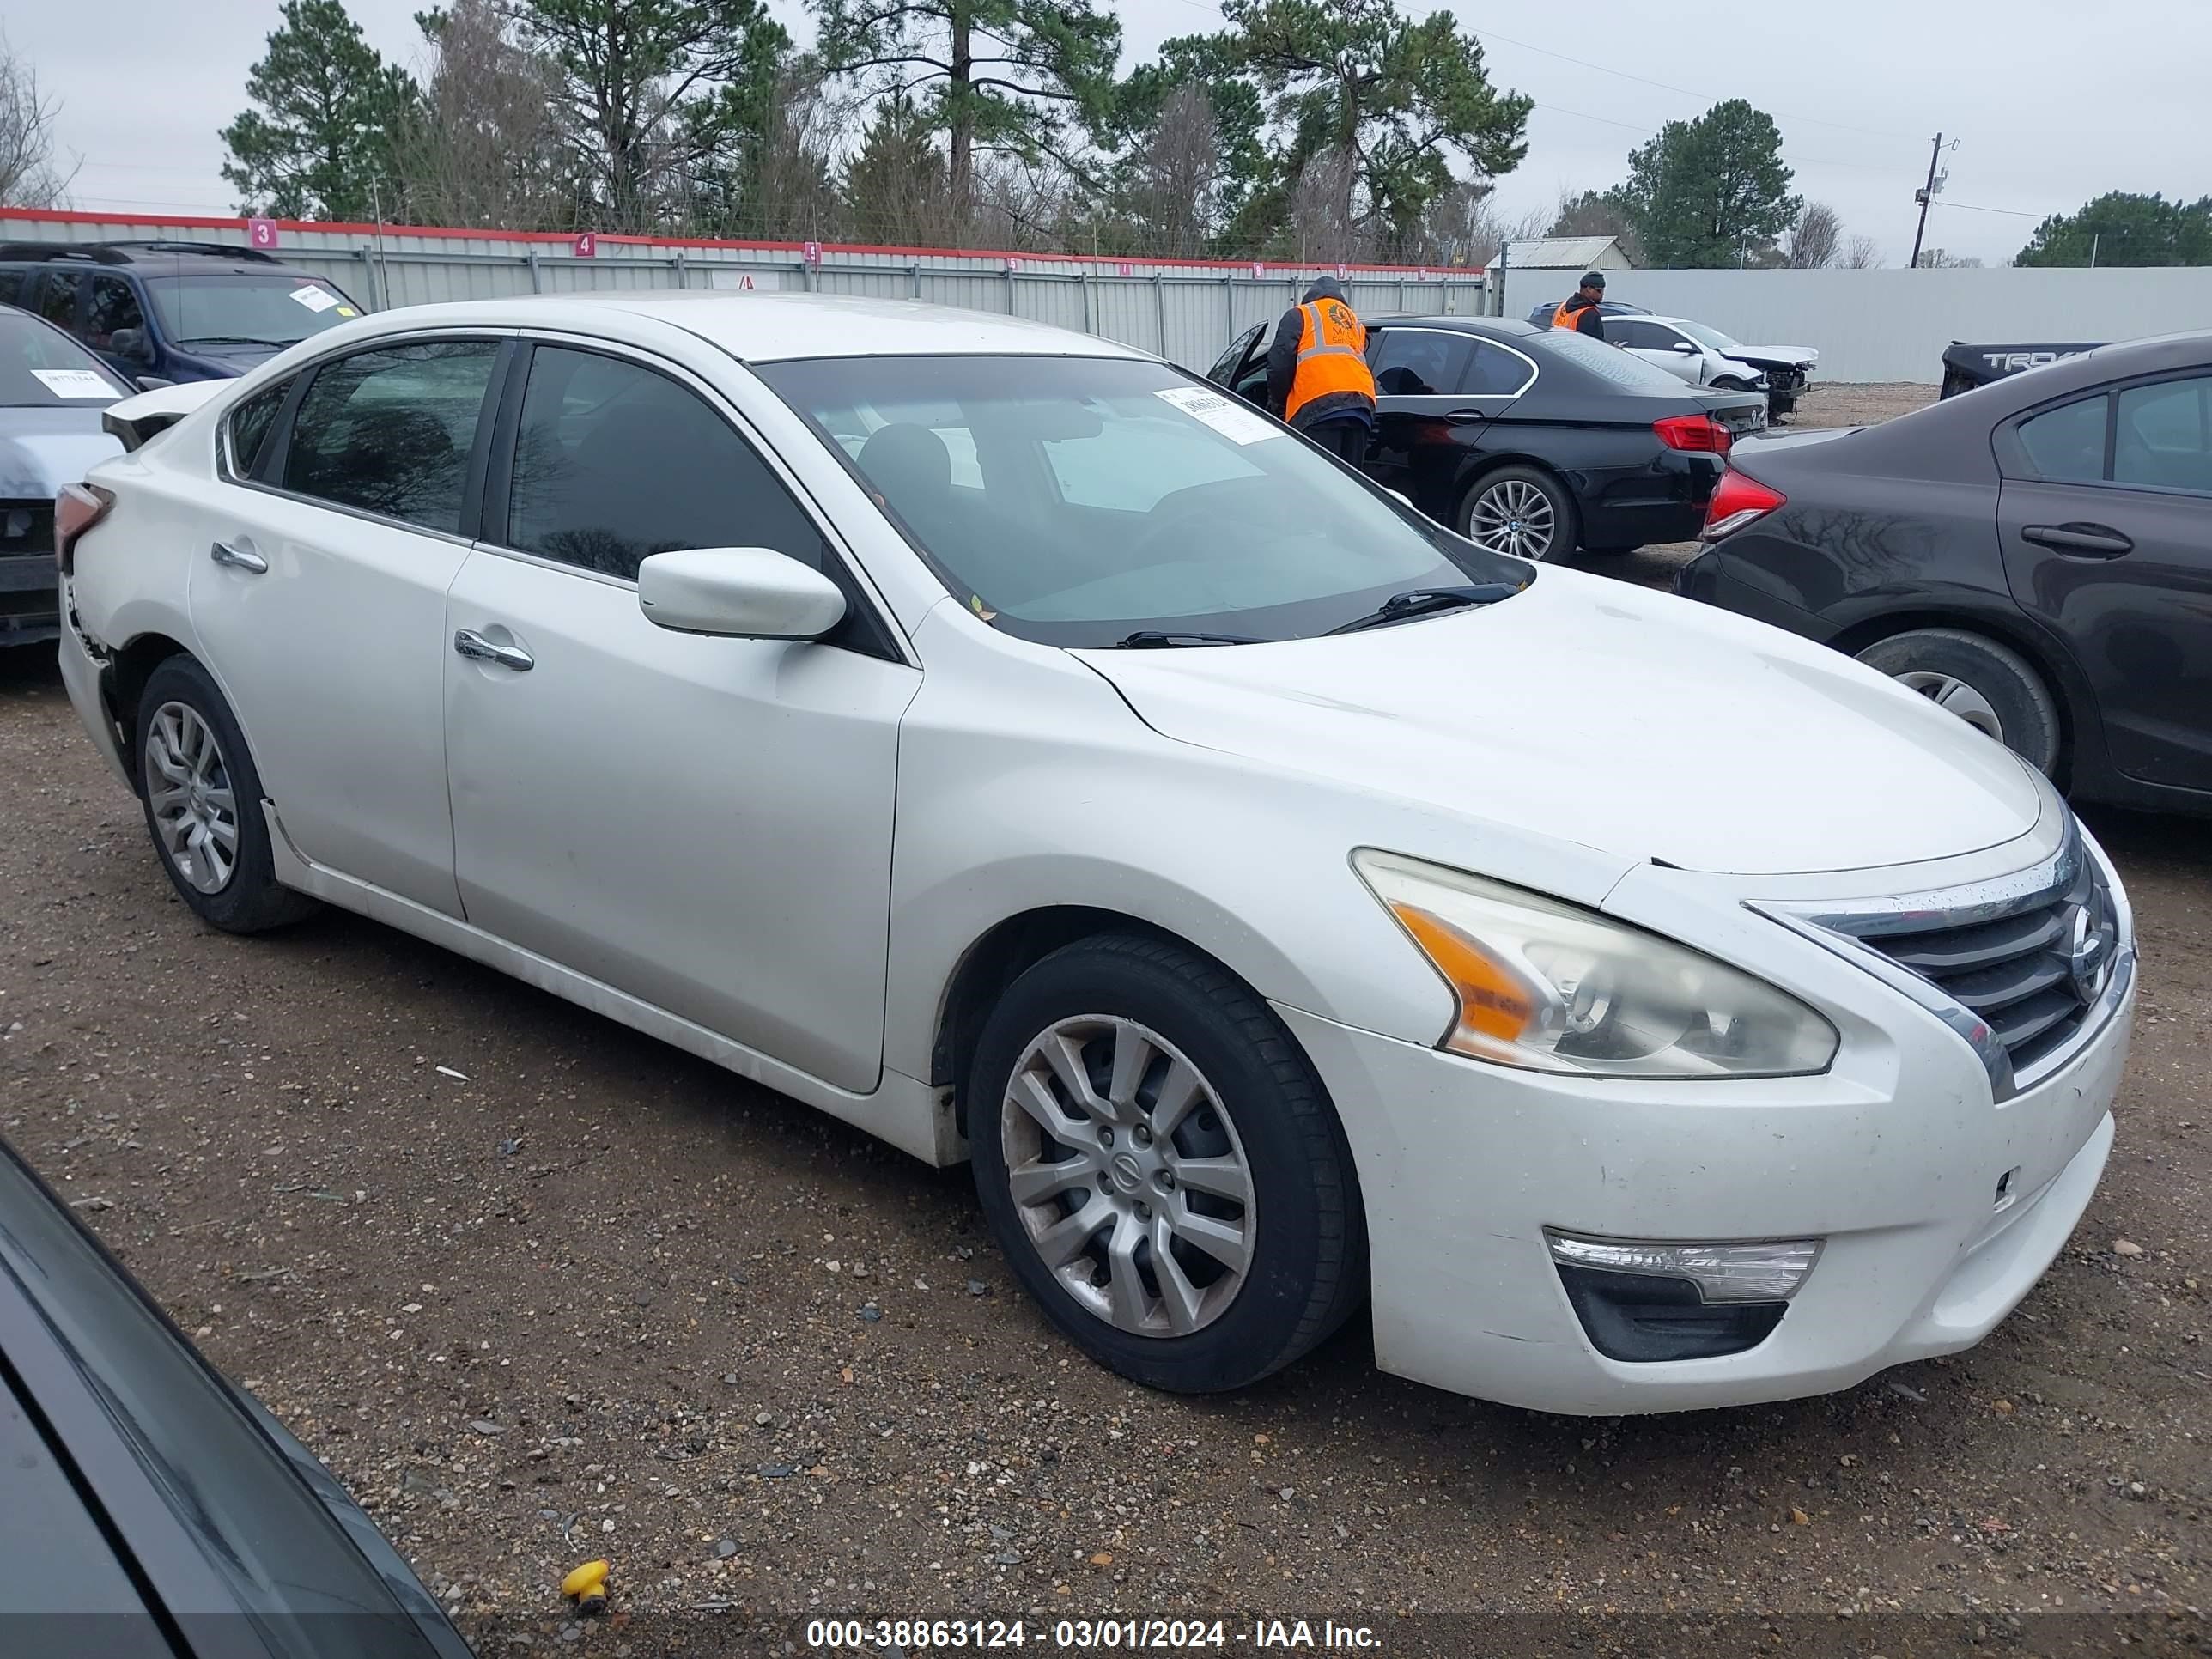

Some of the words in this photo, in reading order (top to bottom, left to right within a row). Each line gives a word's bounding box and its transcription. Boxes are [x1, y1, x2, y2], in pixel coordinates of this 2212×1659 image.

[258, 224, 269, 243] 3
[580, 236, 589, 252] 4
[1255, 265, 1261, 276] 8
[1340, 267, 1344, 278] 9
[1982, 352, 2057, 372] TRD
